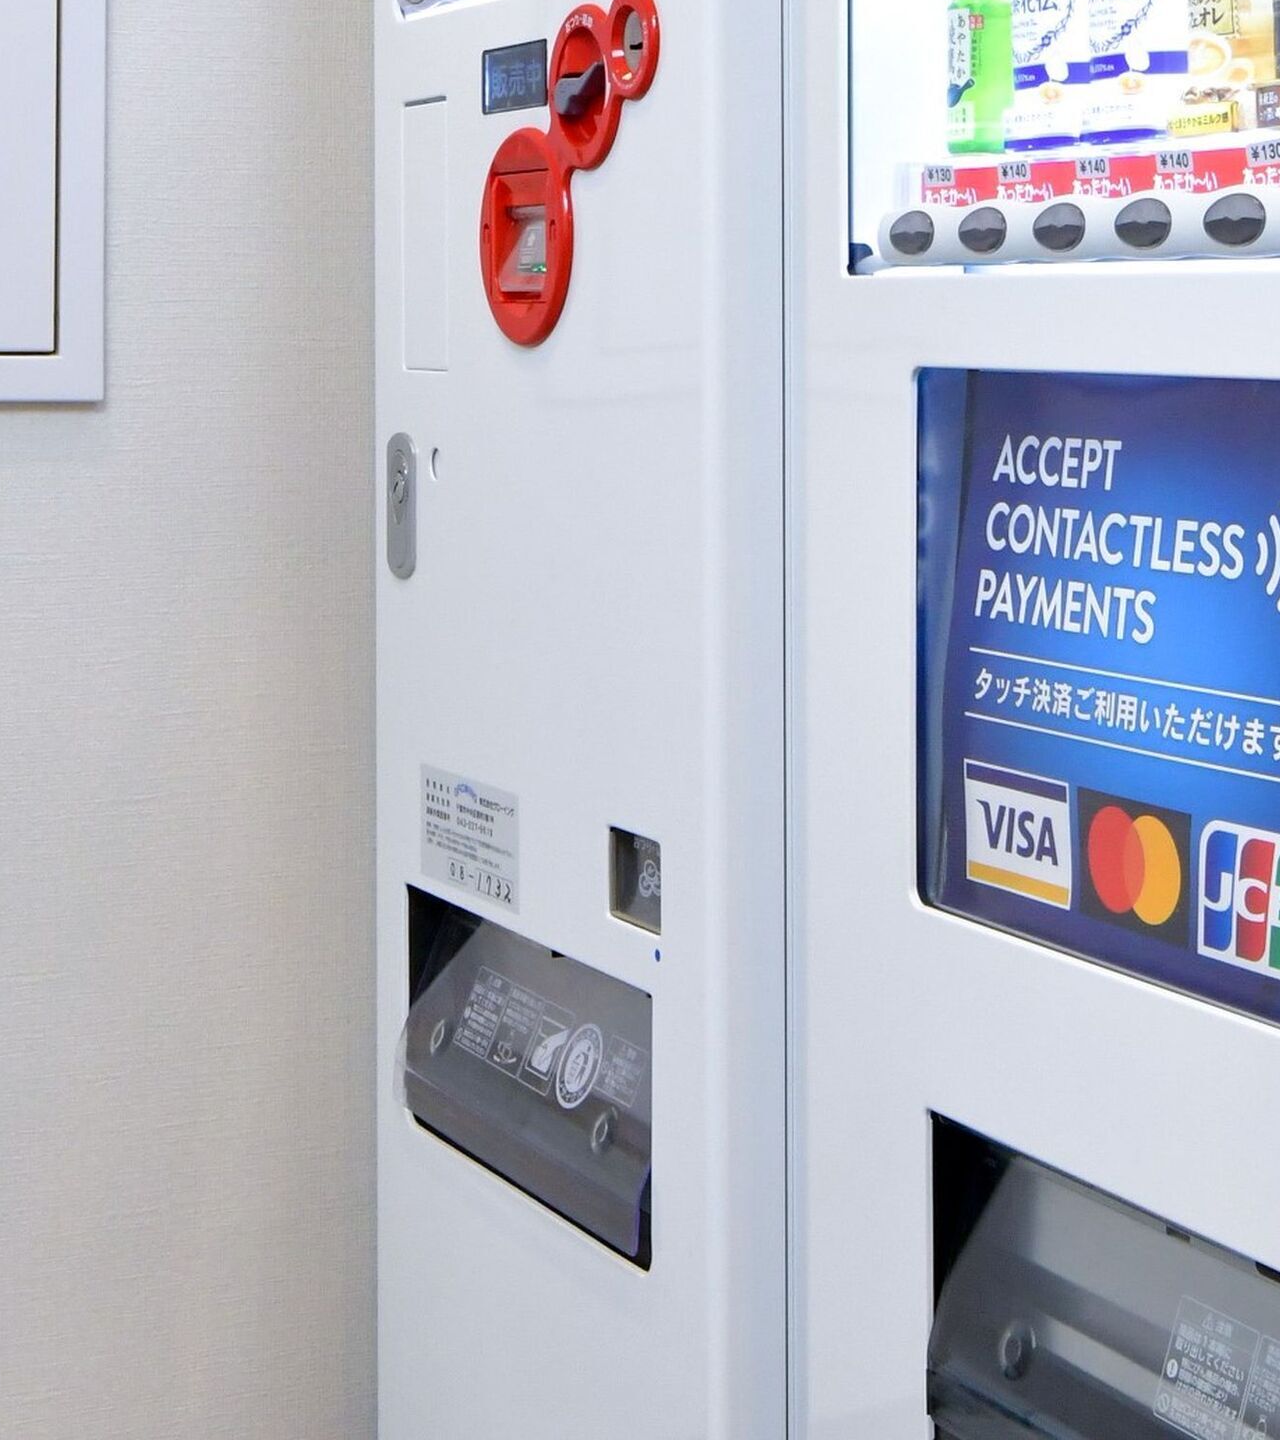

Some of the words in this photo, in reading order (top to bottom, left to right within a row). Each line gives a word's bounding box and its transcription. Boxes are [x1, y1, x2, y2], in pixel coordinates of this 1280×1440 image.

[491, 61, 541, 99] 販売中
[1001, 164, 1027, 178] ¥140
[1080, 159, 1106, 174] ¥140
[1160, 152, 1189, 169] ¥140
[992, 434, 1123, 492] ACCEPT
[985, 501, 1245, 580] CONTACTLESS
[974, 568, 1157, 645] PAYMENTS
[975, 799, 1059, 868] VISA
